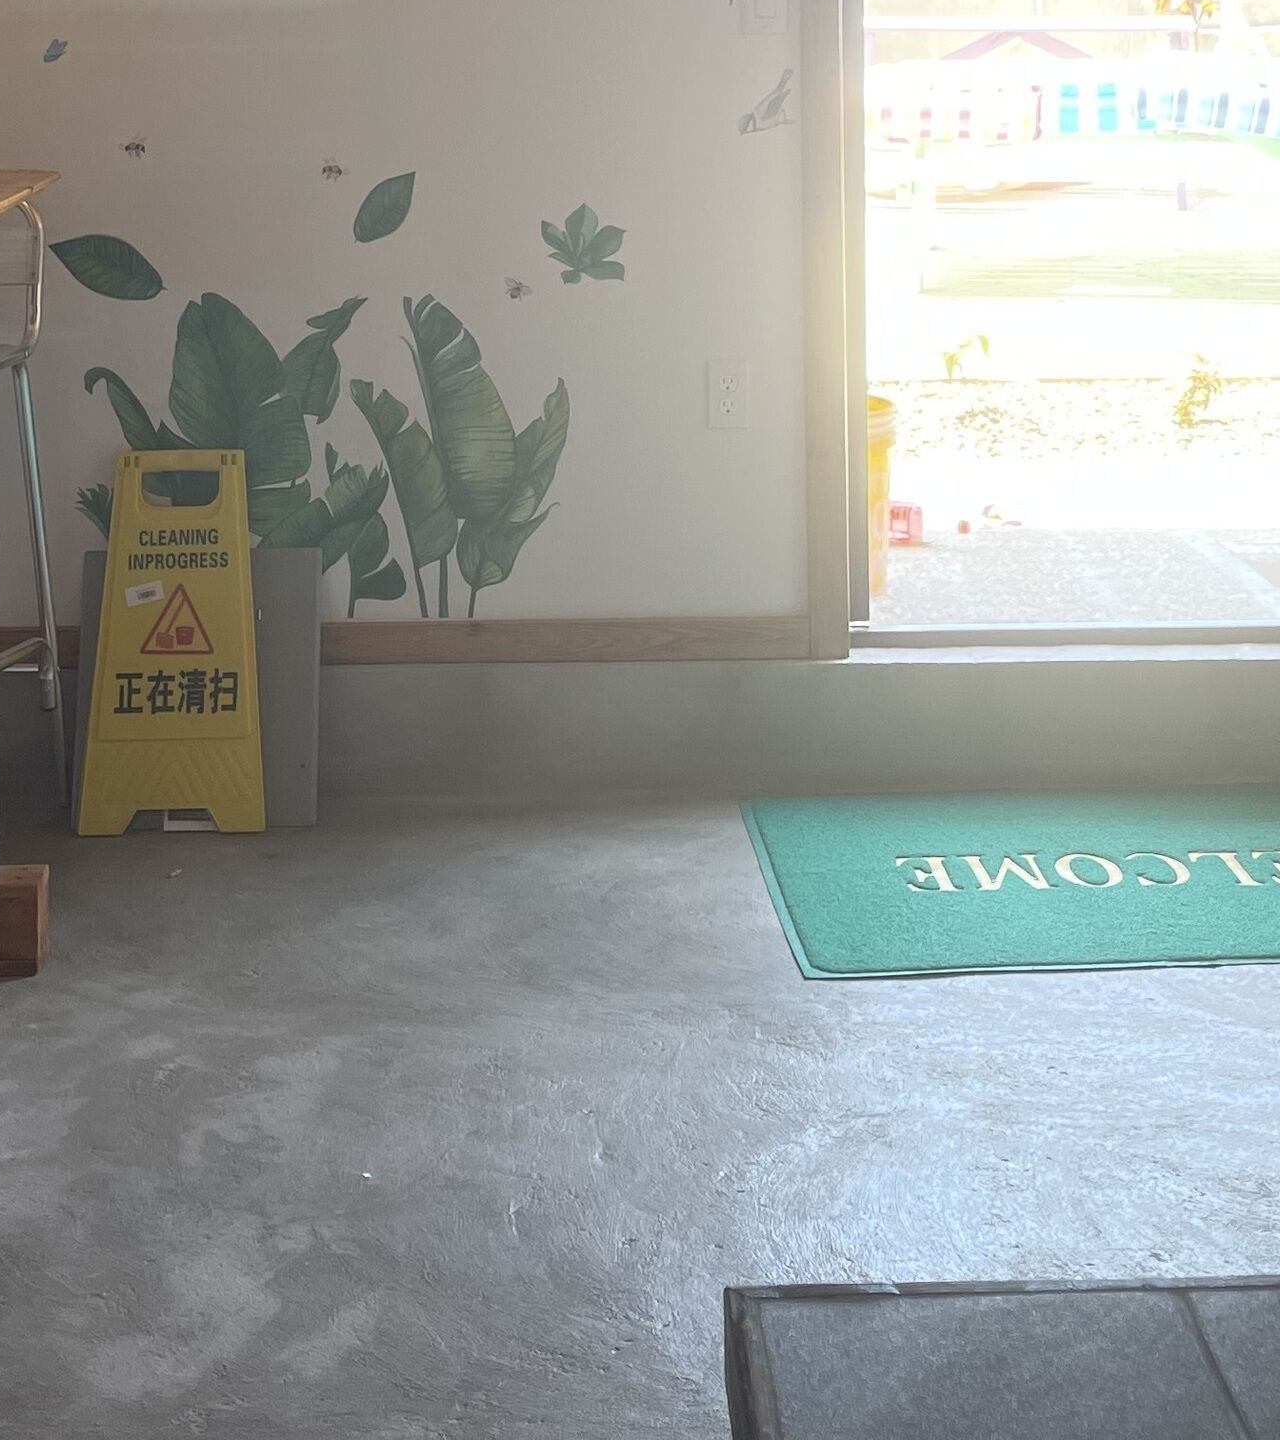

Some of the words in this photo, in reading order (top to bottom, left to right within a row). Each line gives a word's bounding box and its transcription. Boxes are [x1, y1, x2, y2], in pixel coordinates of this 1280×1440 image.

[139, 528, 219, 547] CLEANING
[127, 551, 229, 571] INPROGRESS
[113, 668, 239, 715] 正在清扫
